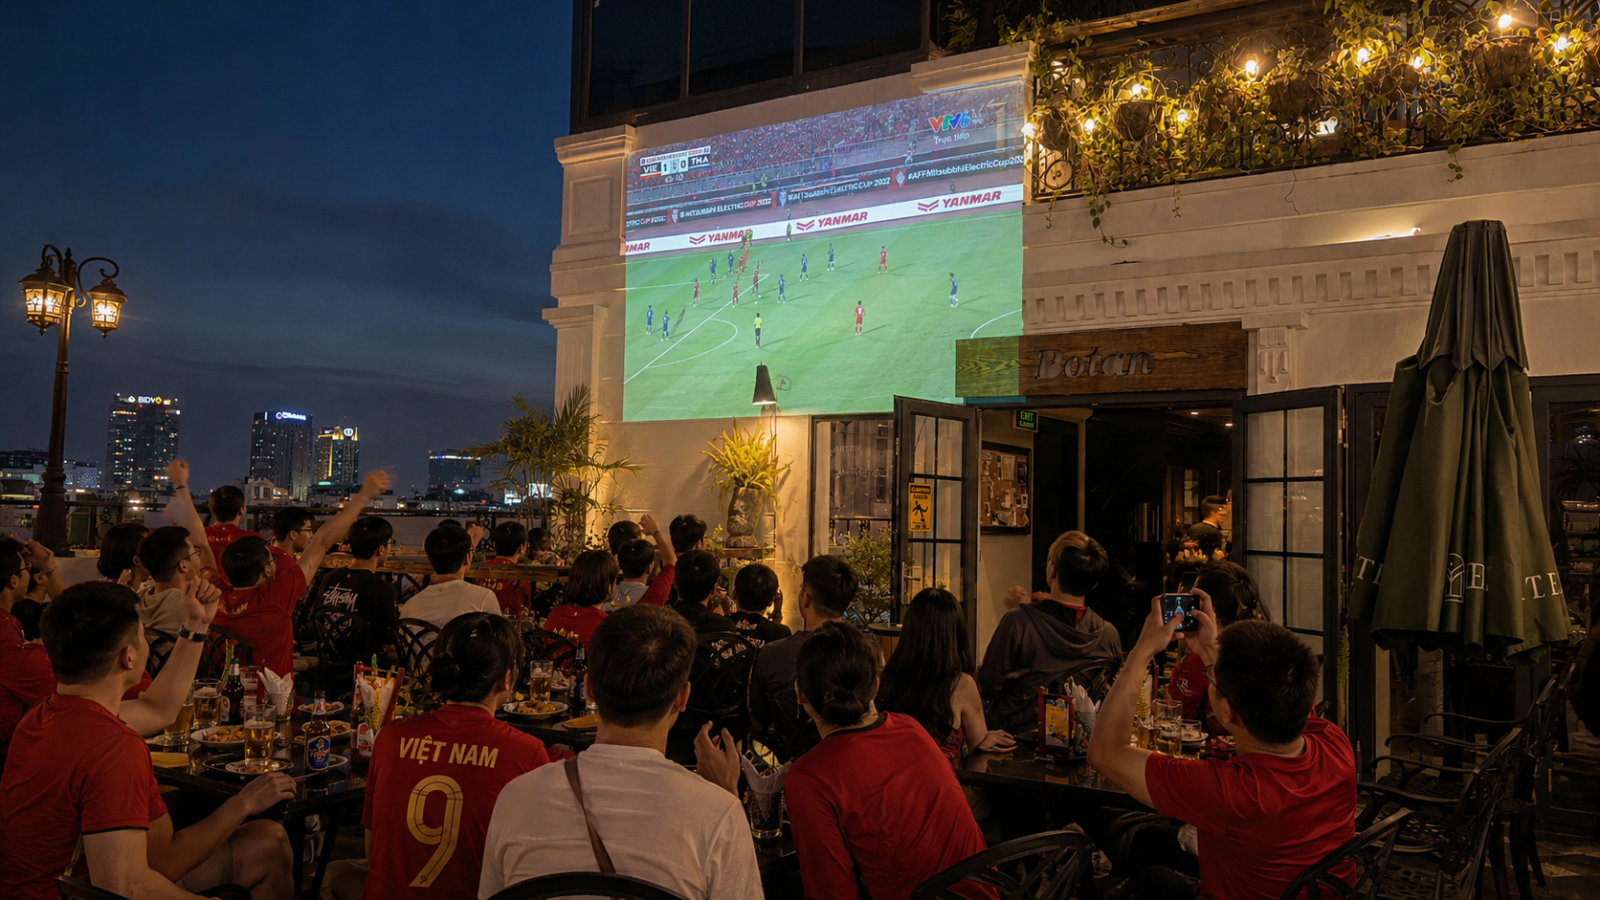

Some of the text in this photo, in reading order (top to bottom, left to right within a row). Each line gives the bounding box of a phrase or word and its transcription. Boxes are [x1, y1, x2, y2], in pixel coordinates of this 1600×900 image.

[928, 111, 971, 133] VTV6
[643, 164, 658, 174] VIE
[663, 163, 668, 172] 1
[680, 159, 687, 169] 0
[691, 155, 709, 165] THA
[942, 190, 1002, 209] YANMAR
[818, 211, 868, 228] YANMAR
[1034, 346, 1152, 380] Botan
[400, 735, 499, 768] VIỆT NAM
[406, 775, 464, 888] 9
